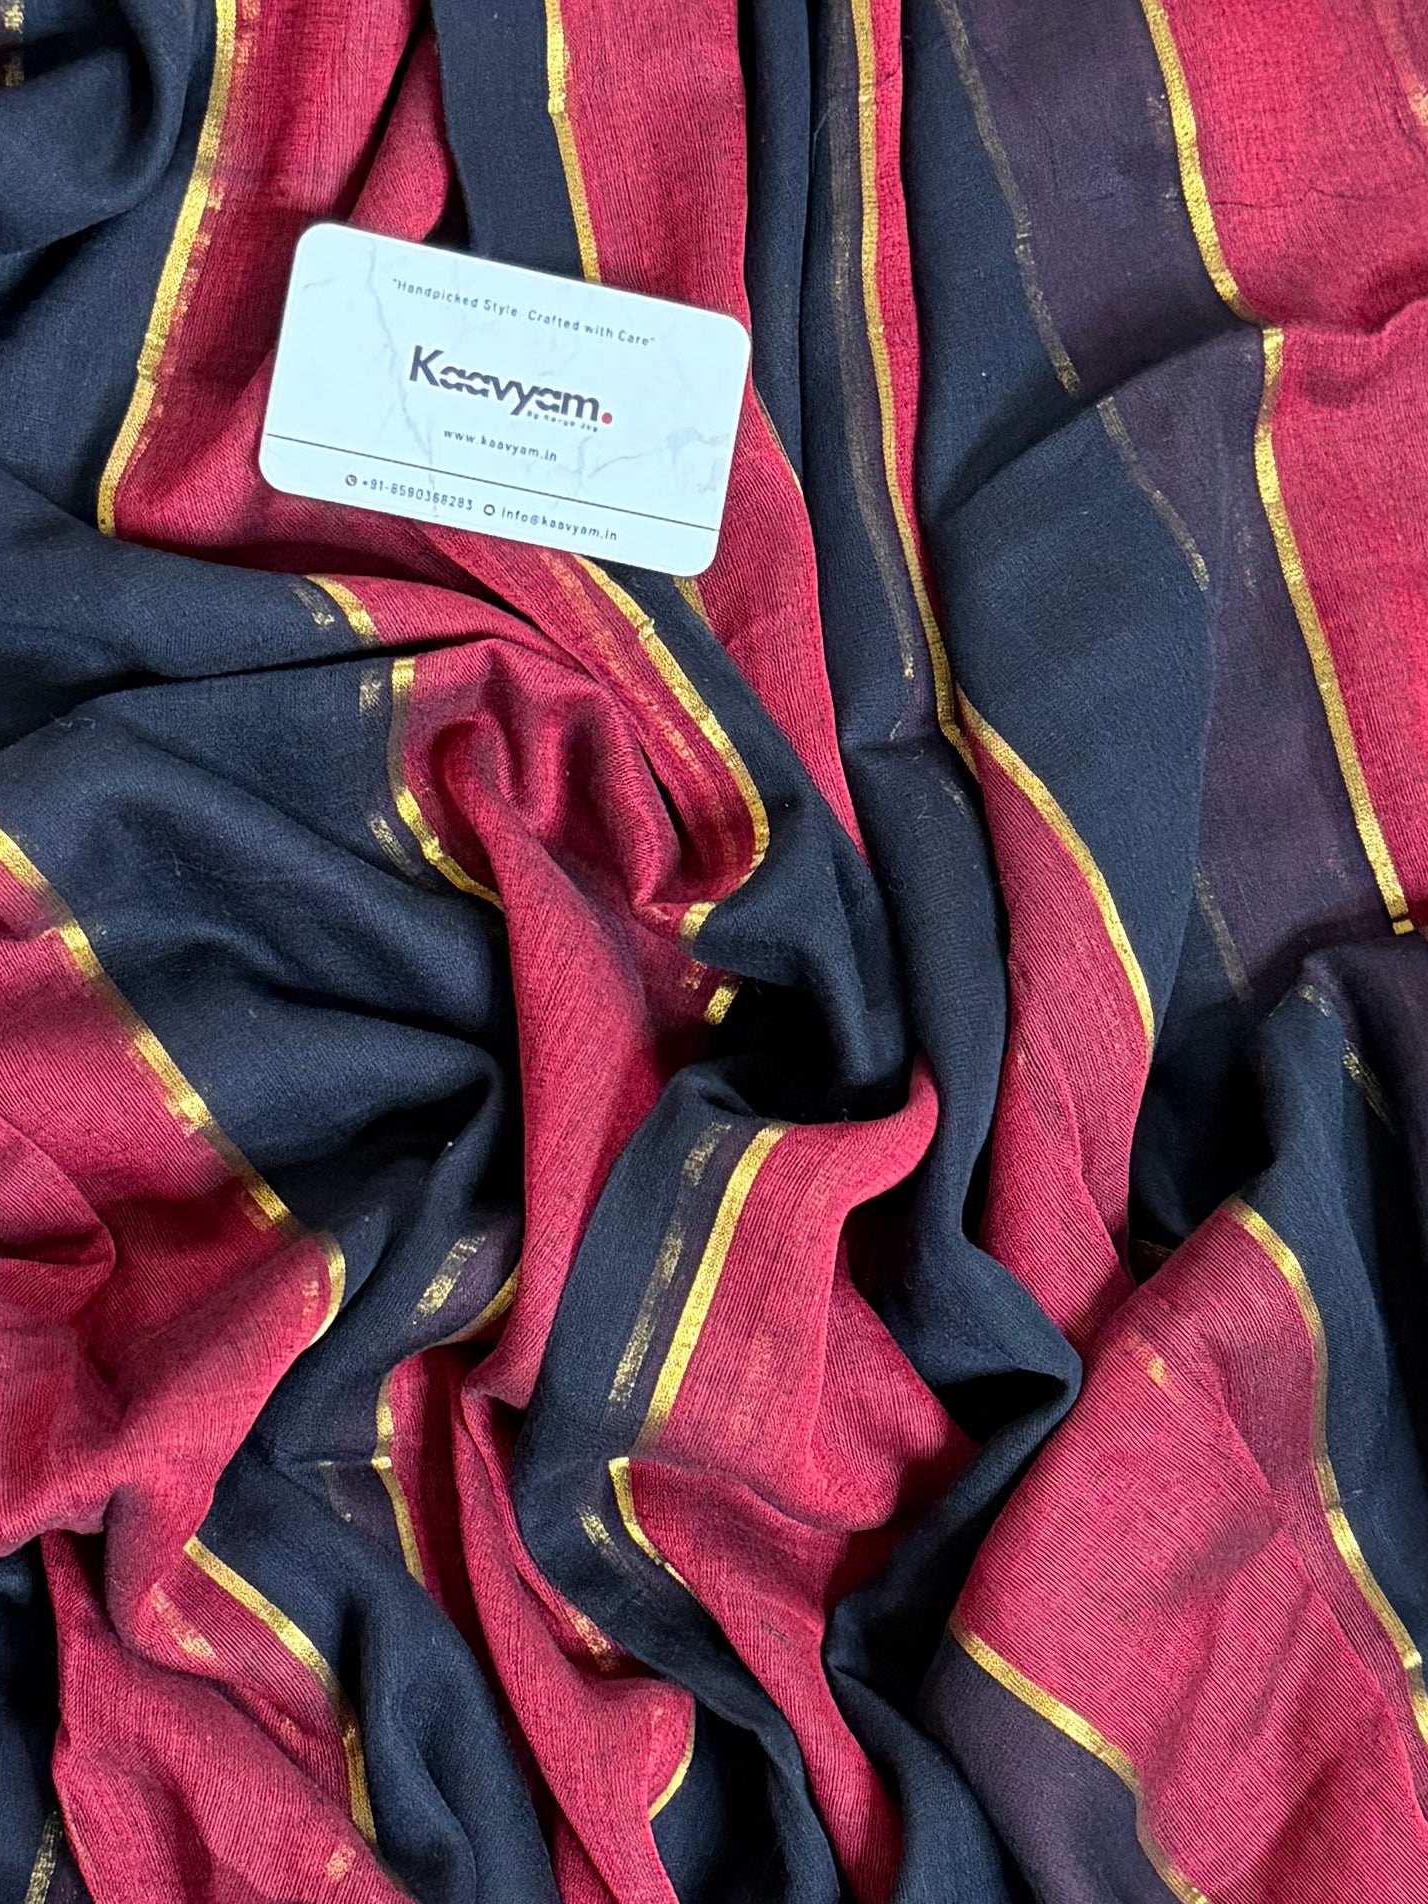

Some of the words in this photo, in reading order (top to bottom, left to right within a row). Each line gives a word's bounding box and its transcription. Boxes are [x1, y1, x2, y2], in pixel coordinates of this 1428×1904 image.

[483, 298, 522, 319] Style
[527, 309, 580, 332] Crafted
[584, 324, 614, 338] with
[443, 430, 557, 462] www.kaavyam.in
